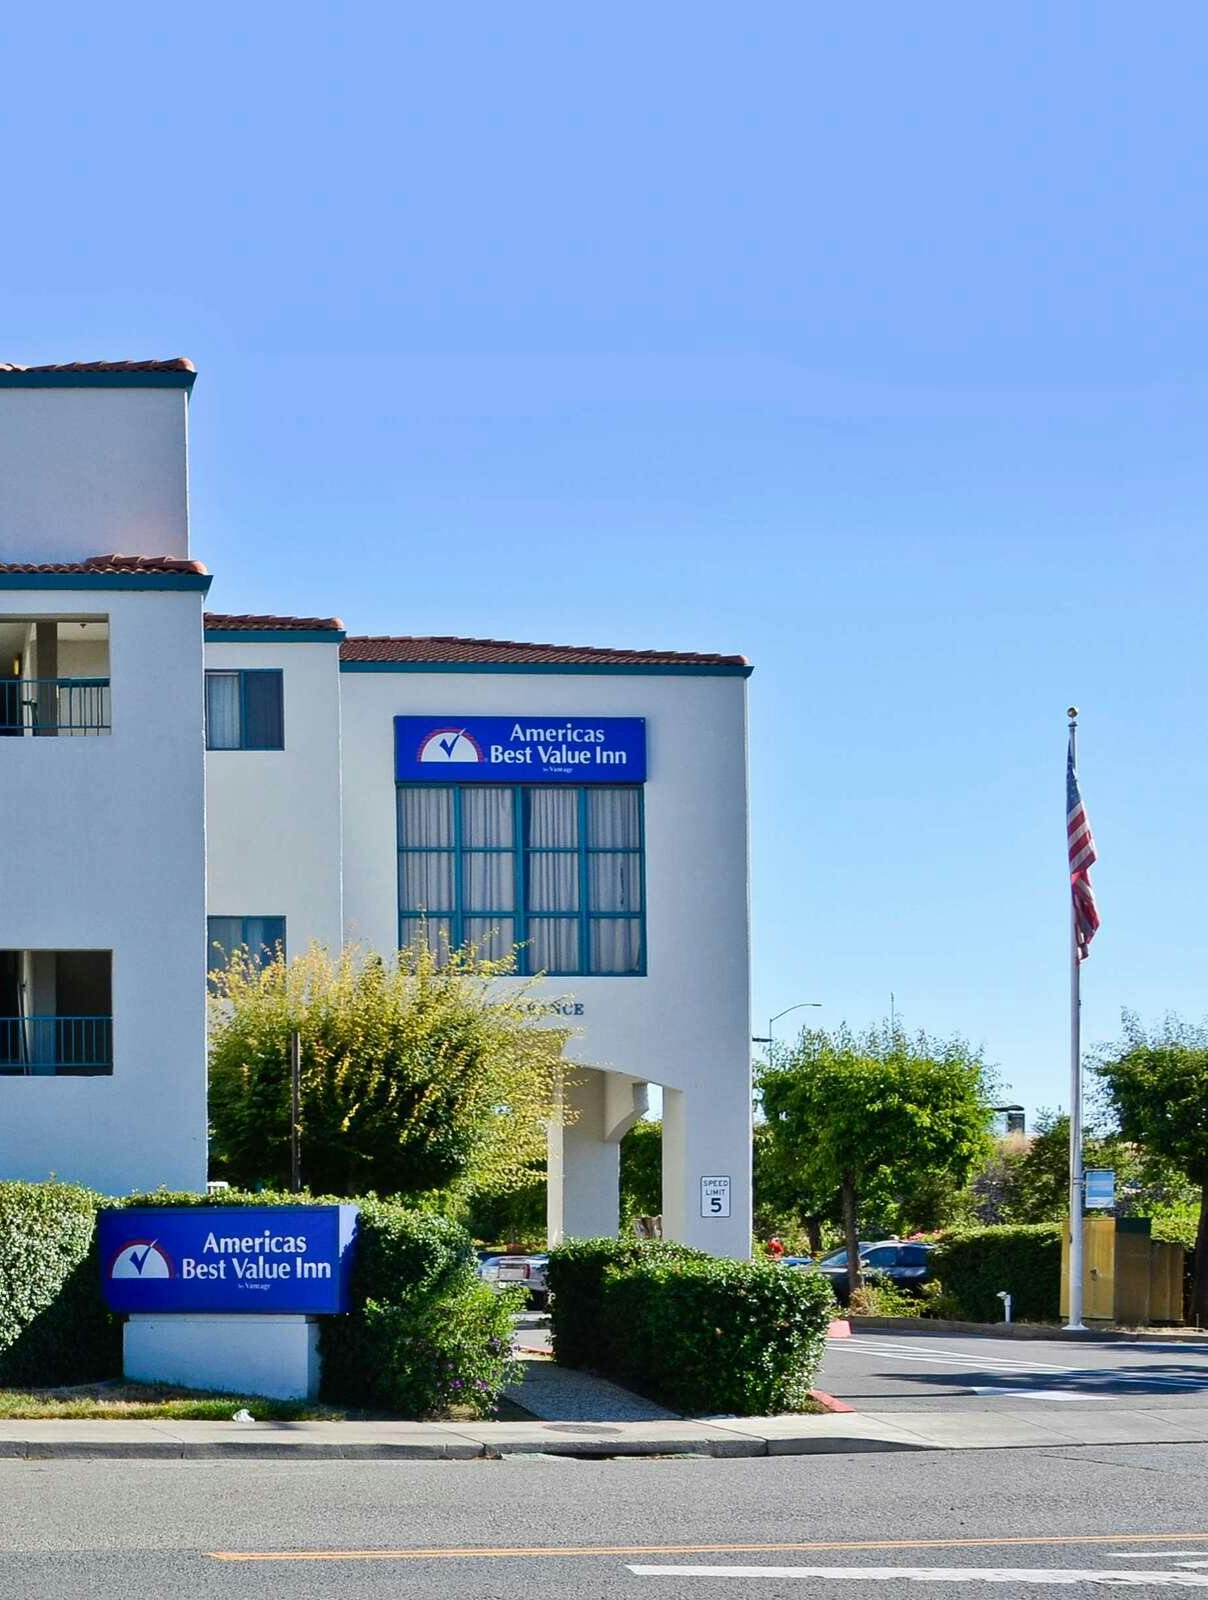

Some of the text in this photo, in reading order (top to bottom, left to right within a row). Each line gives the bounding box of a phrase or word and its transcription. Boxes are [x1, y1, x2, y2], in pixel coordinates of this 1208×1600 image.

[510, 723, 605, 743] Americas
[490, 745, 627, 764] Best Value Inn
[711, 1197, 722, 1213] 5
[202, 1230, 307, 1254] Americas
[182, 1255, 331, 1280] Best Value Inn
